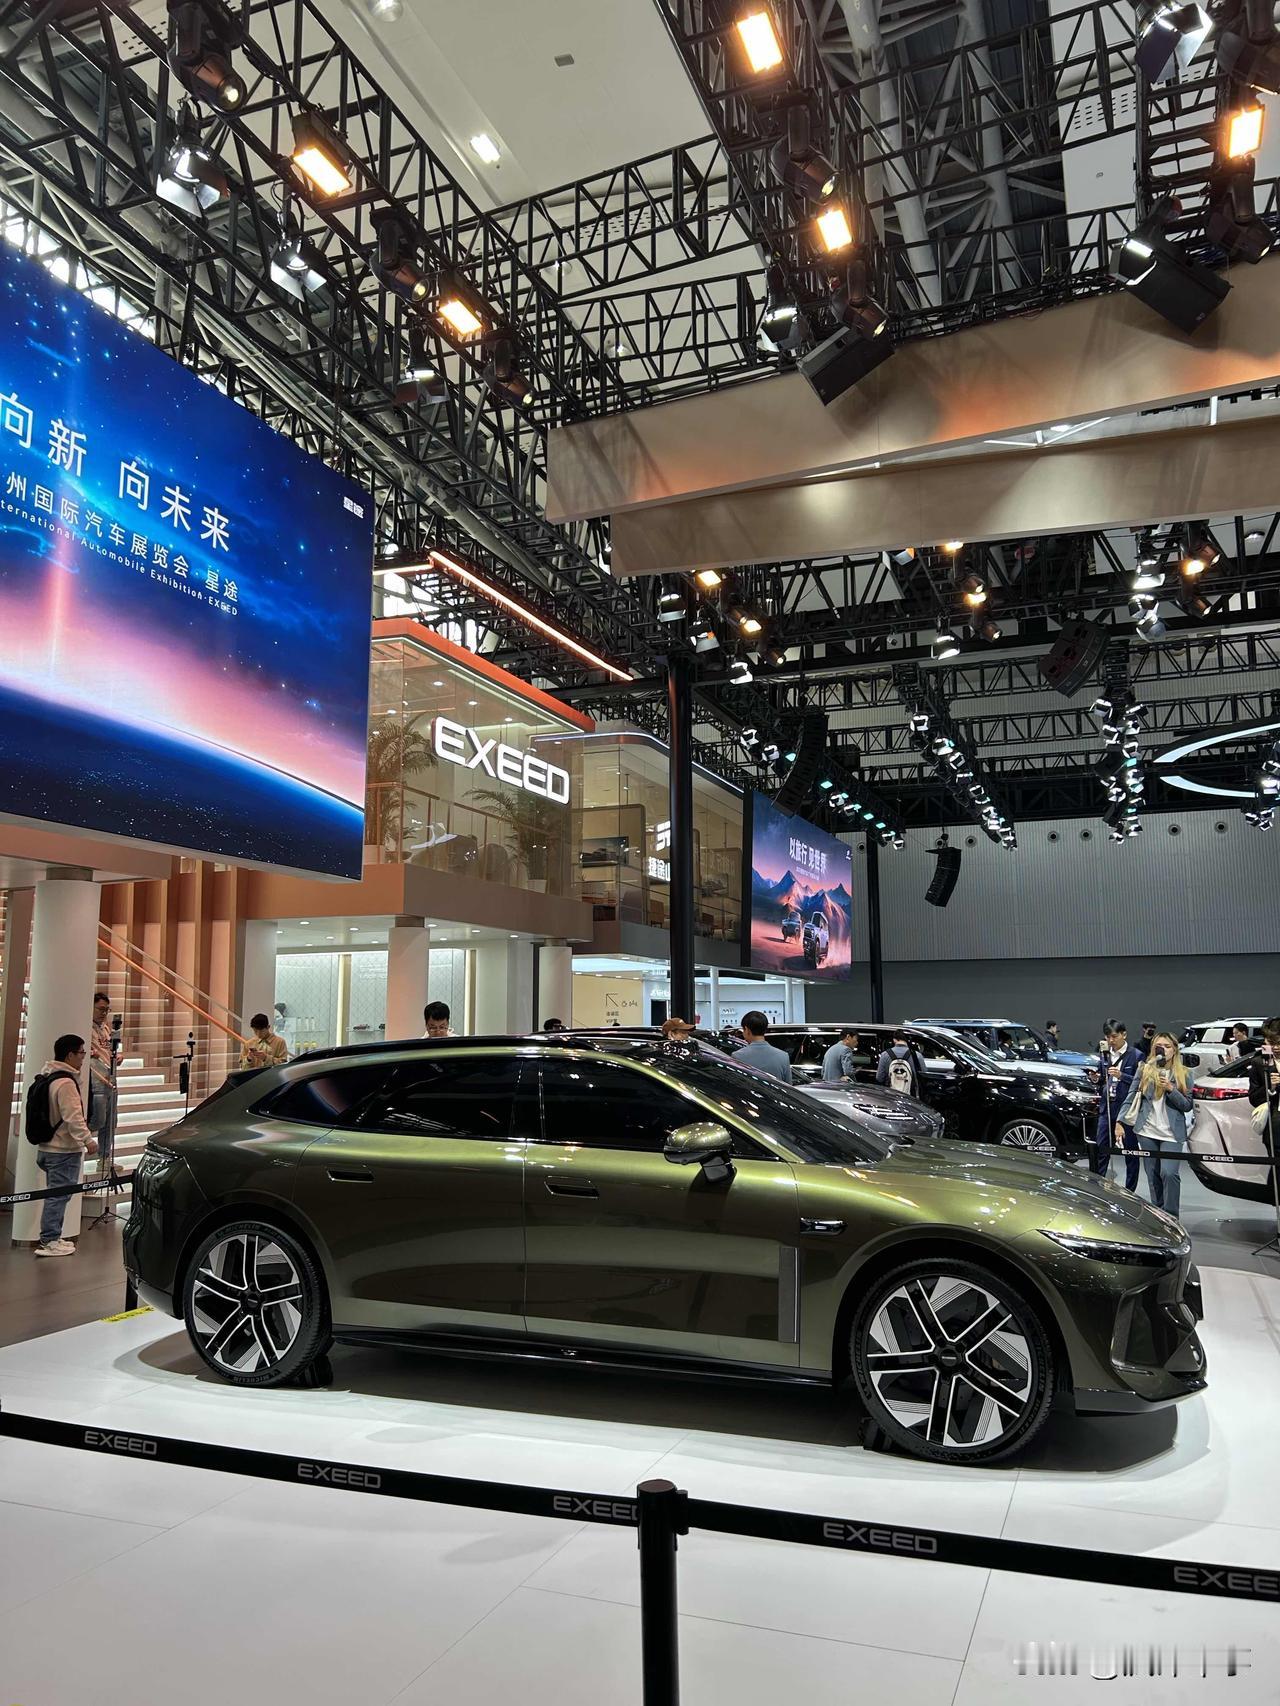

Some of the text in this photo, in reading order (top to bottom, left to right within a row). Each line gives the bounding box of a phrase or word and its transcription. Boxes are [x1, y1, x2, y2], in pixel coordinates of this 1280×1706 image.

[0, 392, 231, 552] 向新 向未来
[81, 537, 146, 574] Automobile
[434, 716, 570, 805] EXEED
[1121, 1149, 1150, 1157] EXEED
[0, 1180, 110, 1203] EXEED EXEED
[84, 1430, 158, 1455] EXEED
[297, 1462, 381, 1489] EXEED
[823, 1521, 1280, 1595] EXEED EXEE
